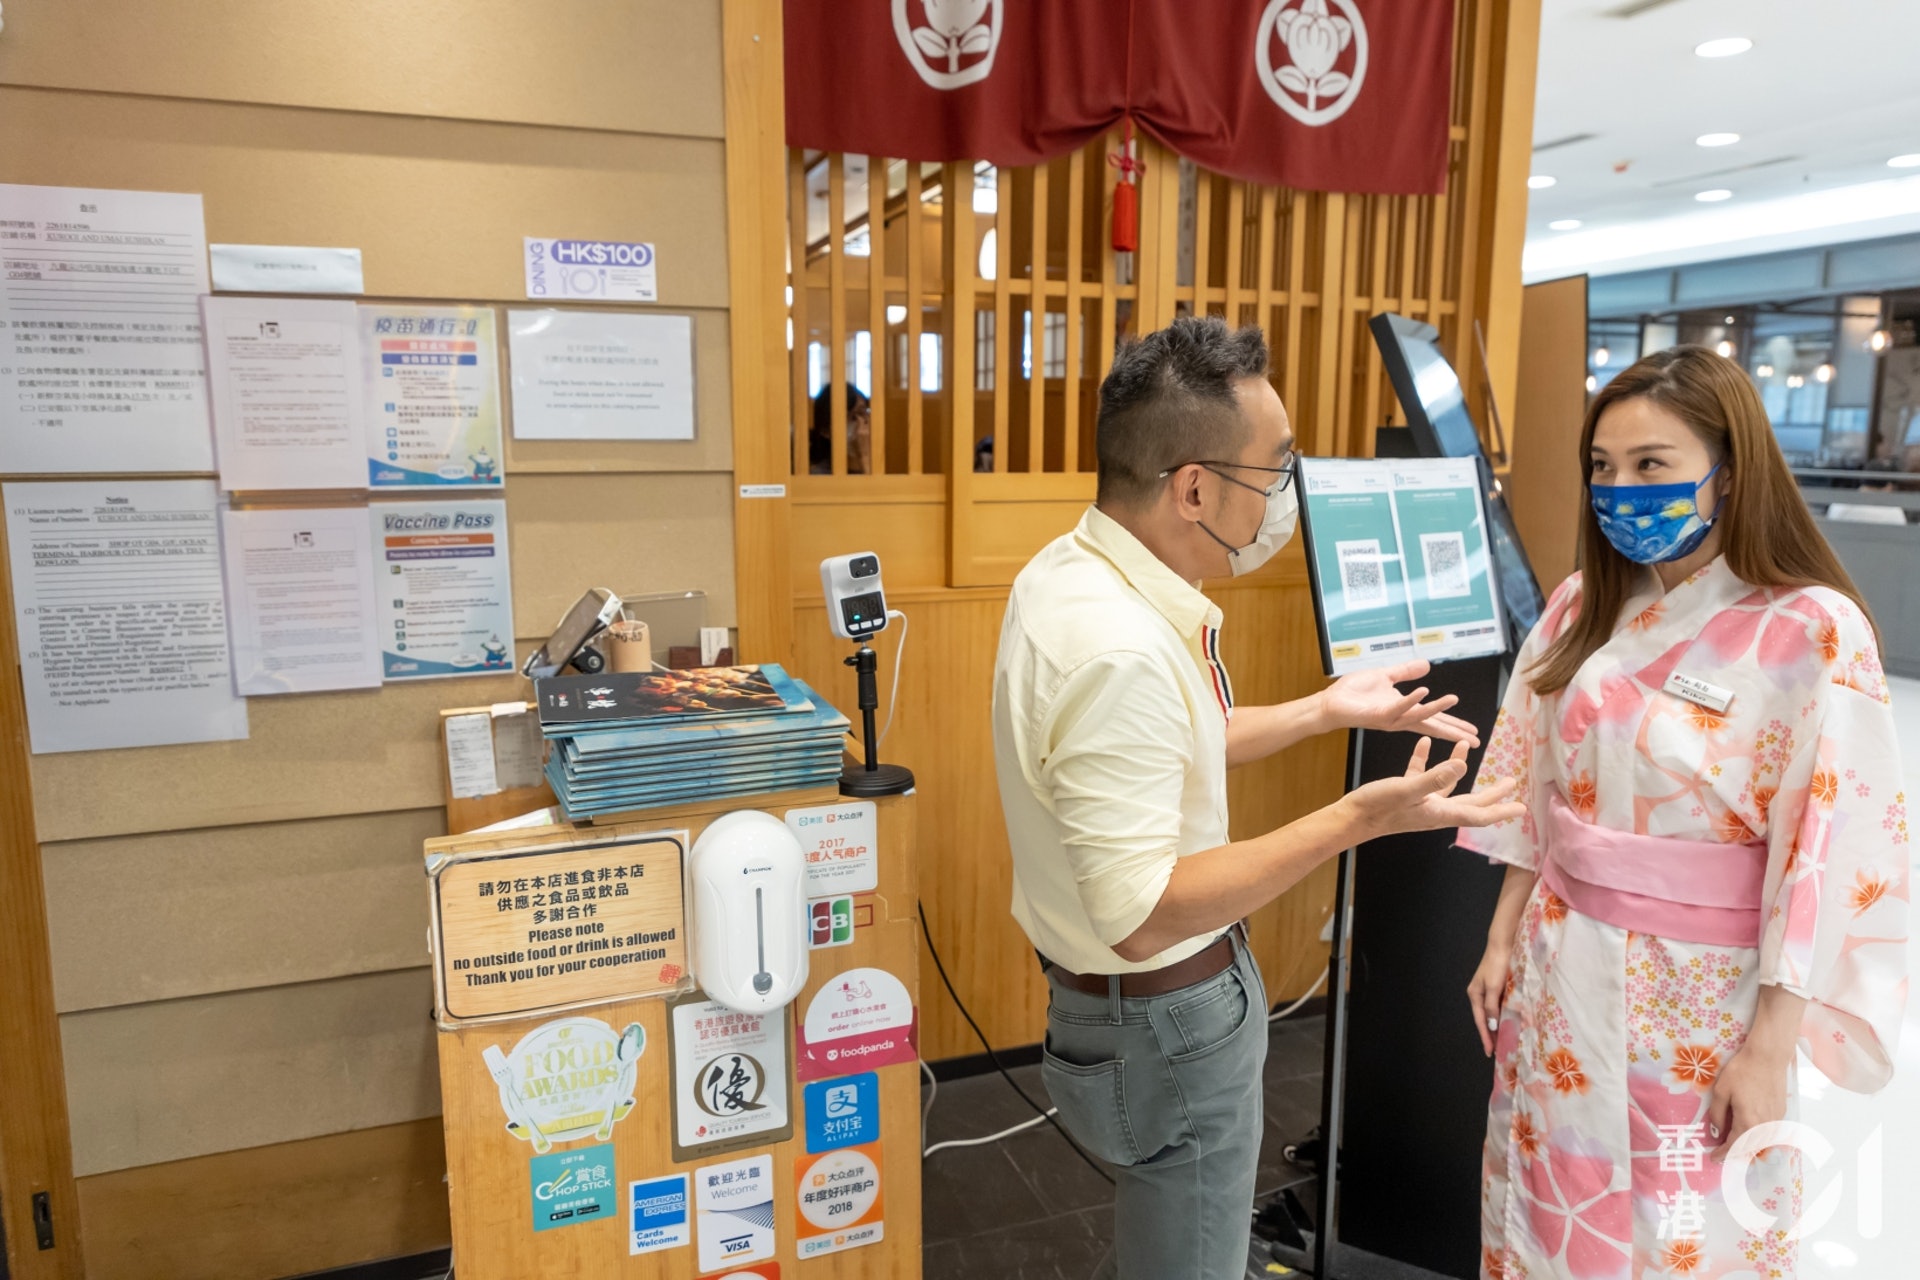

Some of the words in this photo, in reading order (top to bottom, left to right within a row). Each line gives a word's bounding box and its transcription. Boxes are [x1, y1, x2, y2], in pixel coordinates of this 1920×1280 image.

[81, 233, 99, 241] AND
[557, 243, 647, 265] HK$100
[530, 242, 546, 295] DINING
[384, 512, 449, 531] Vaccine
[453, 511, 494, 529] Pass
[410, 537, 439, 545] Catering
[818, 837, 846, 849] 2017
[478, 864, 645, 897] 請勿在本店進食非本店
[497, 882, 629, 912] 供應之食品或飲品
[532, 903, 598, 924] 多謝合作
[528, 926, 573, 944] Please
[575, 922, 605, 936] note
[453, 958, 470, 970] no
[473, 950, 524, 969] outside
[528, 946, 557, 962] food
[559, 944, 573, 956] or
[576, 937, 609, 954] drink
[612, 936, 624, 949] is
[626, 928, 676, 947] allowed
[465, 970, 507, 987] Thank
[510, 968, 533, 983] you
[536, 963, 555, 978] for
[558, 960, 586, 976] your
[589, 948, 667, 970] cooperation
[827, 1023, 850, 1033] order
[851, 1019, 874, 1028] online
[875, 1016, 891, 1024] now
[840, 1040, 894, 1058] foodpanda
[523, 1040, 614, 1078] FOOD
[521, 1064, 619, 1101] AWARDS
[823, 1116, 862, 1134] 支付宝
[827, 1131, 859, 1142] ALIPAY
[708, 1167, 761, 1188] 歡迎光臨
[827, 1166, 865, 1183] 大众点评
[581, 1179, 611, 1192] STICK
[710, 1182, 758, 1200] Welcome
[804, 1179, 874, 1204] 年度好评商户
[634, 1193, 682, 1208] AMERICAN
[644, 1202, 686, 1217] EXPRESS
[827, 1201, 853, 1217] 2018
[636, 1229, 664, 1240] Cards
[636, 1235, 679, 1249] Welcome
[846, 1229, 875, 1242] 大众点评
[725, 1240, 751, 1253] VISA
